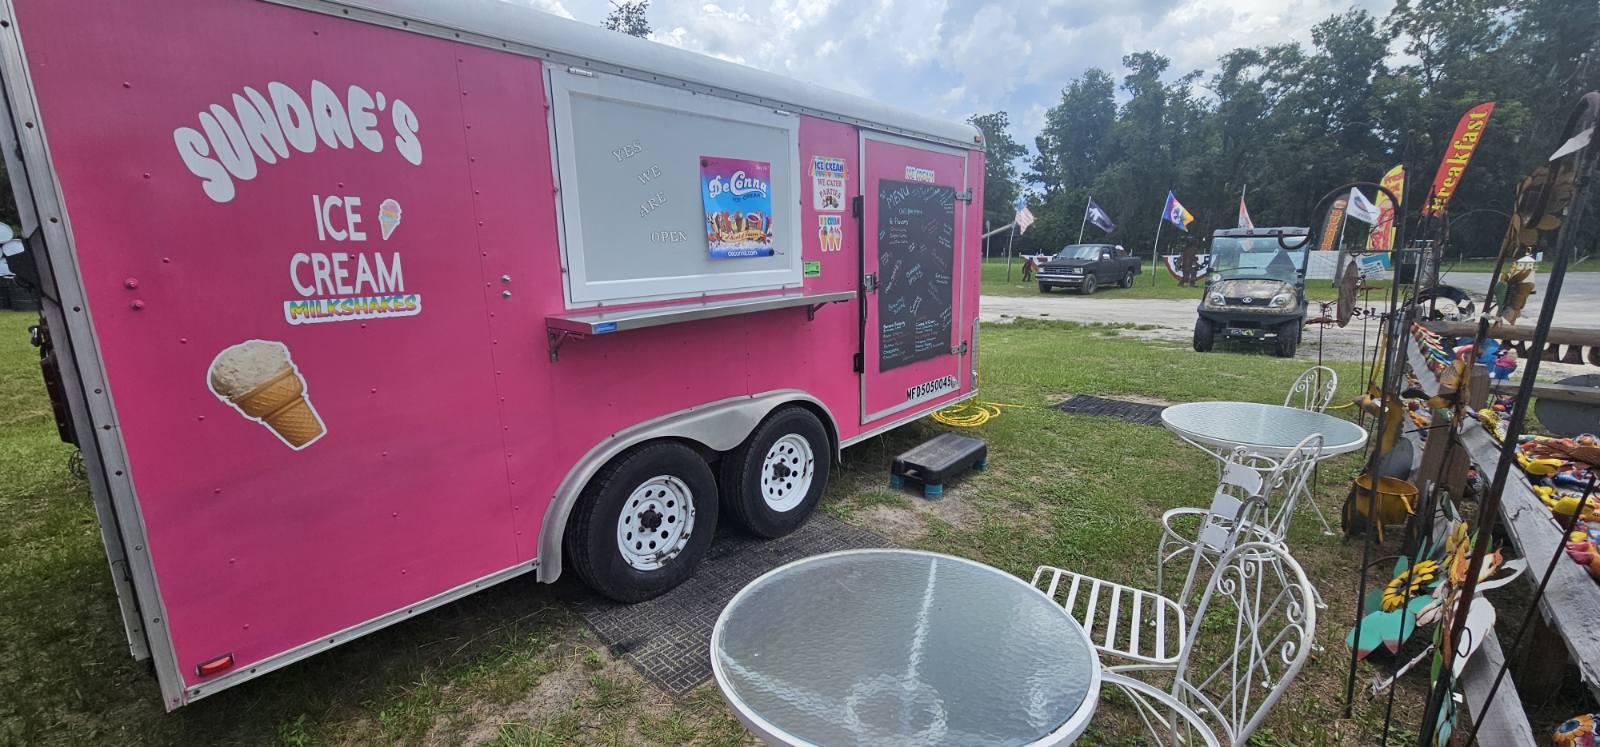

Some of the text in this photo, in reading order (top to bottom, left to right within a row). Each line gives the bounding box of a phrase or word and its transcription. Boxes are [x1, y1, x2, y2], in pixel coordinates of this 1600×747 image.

[173, 79, 423, 203] SUNDAE'S
[612, 140, 642, 161] YES
[638, 164, 661, 184] WE
[814, 161, 844, 173] ICE CREAM
[640, 191, 667, 217] ARE
[312, 194, 367, 241] ICE
[650, 231, 688, 242] OPEN
[289, 251, 405, 297] CREAM
[288, 295, 418, 320] MILKSHAKES
